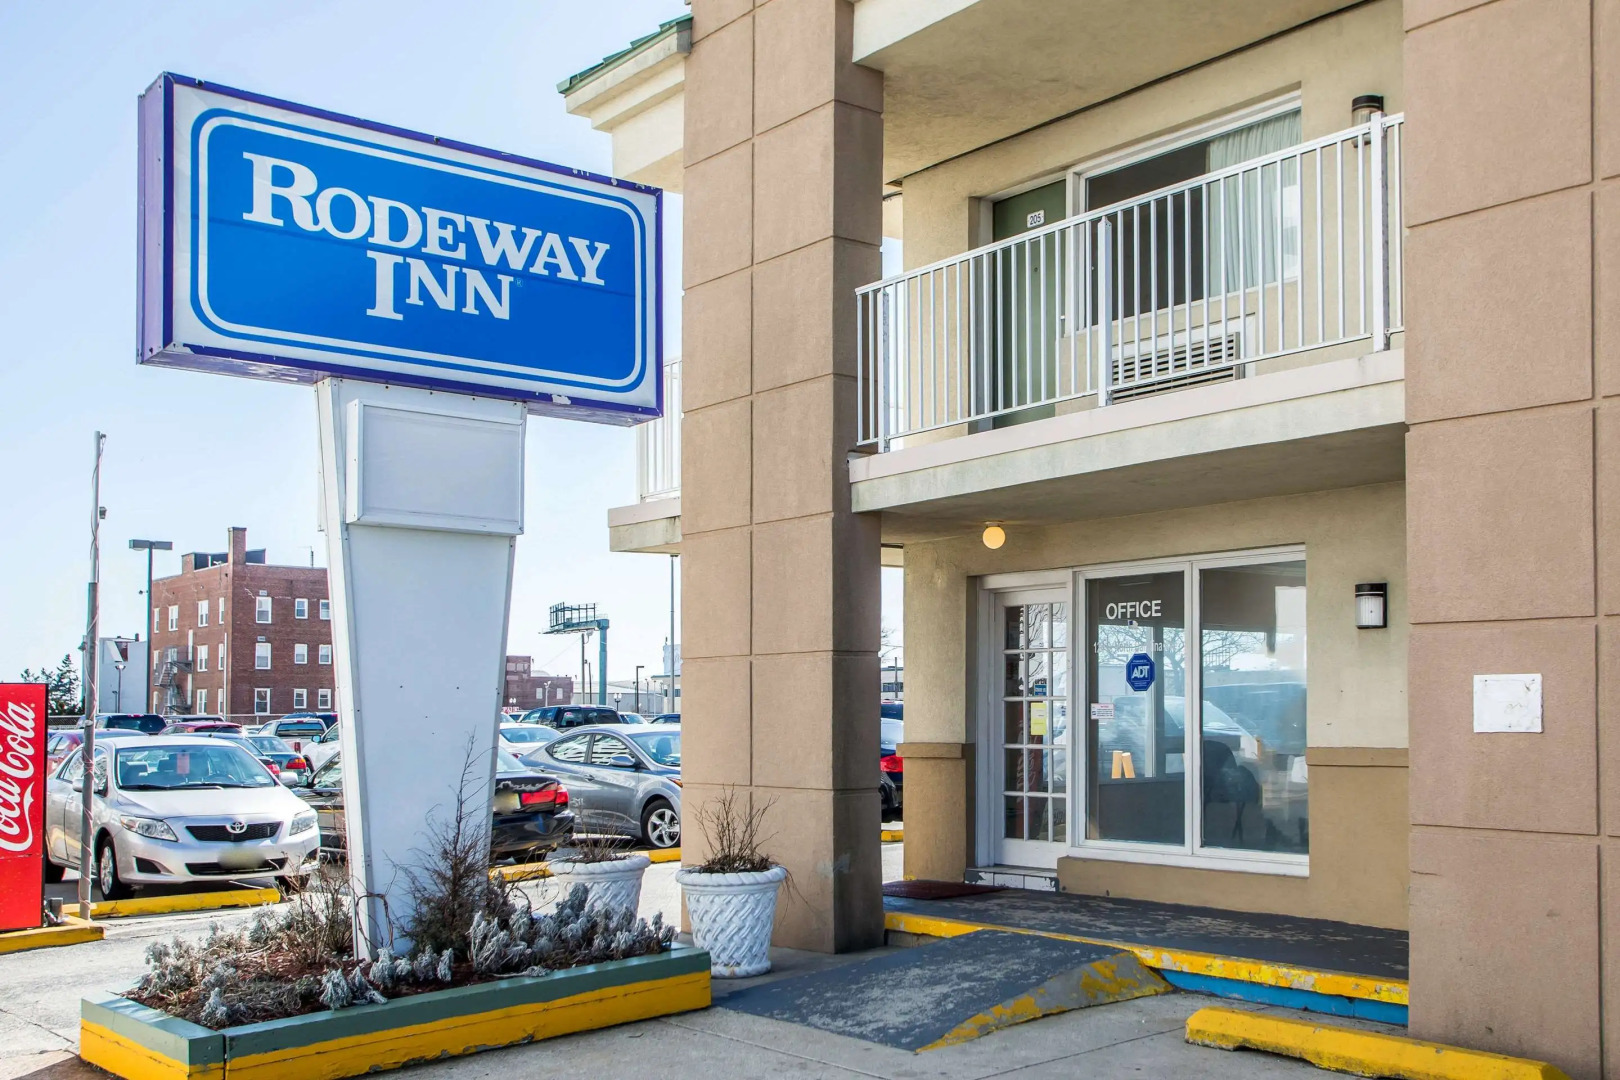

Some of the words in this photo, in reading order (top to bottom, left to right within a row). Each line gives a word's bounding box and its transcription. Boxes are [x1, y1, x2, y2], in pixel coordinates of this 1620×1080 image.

[242, 152, 610, 286] RODEWAY
[1030, 214, 1041, 225] 205
[366, 250, 514, 321] INN
[1105, 600, 1162, 620] OFFICE
[1131, 665, 1150, 679] ADT
